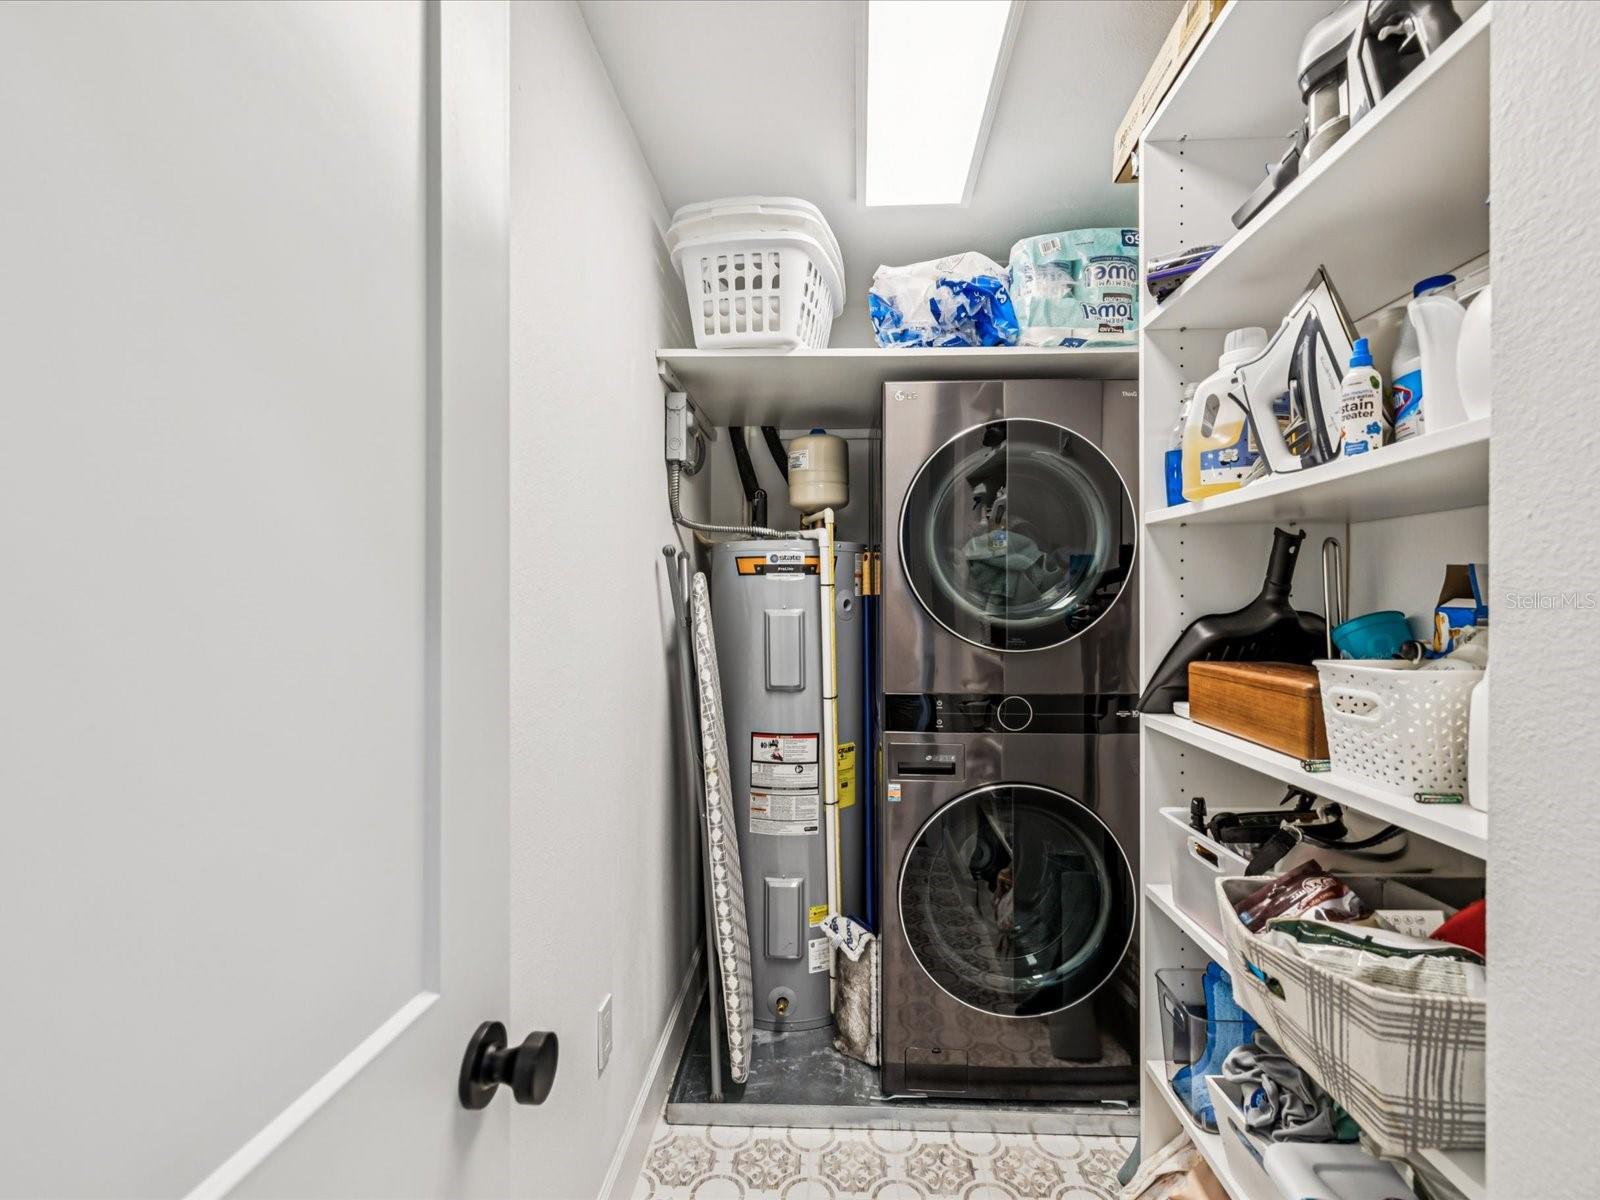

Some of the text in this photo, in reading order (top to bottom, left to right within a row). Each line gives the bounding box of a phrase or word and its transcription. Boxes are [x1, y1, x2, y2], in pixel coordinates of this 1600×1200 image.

[1084, 266, 1137, 287] owel
[1082, 303, 1134, 321] Towel
[1342, 398, 1374, 414] stain
[1342, 410, 1374, 421] reater
